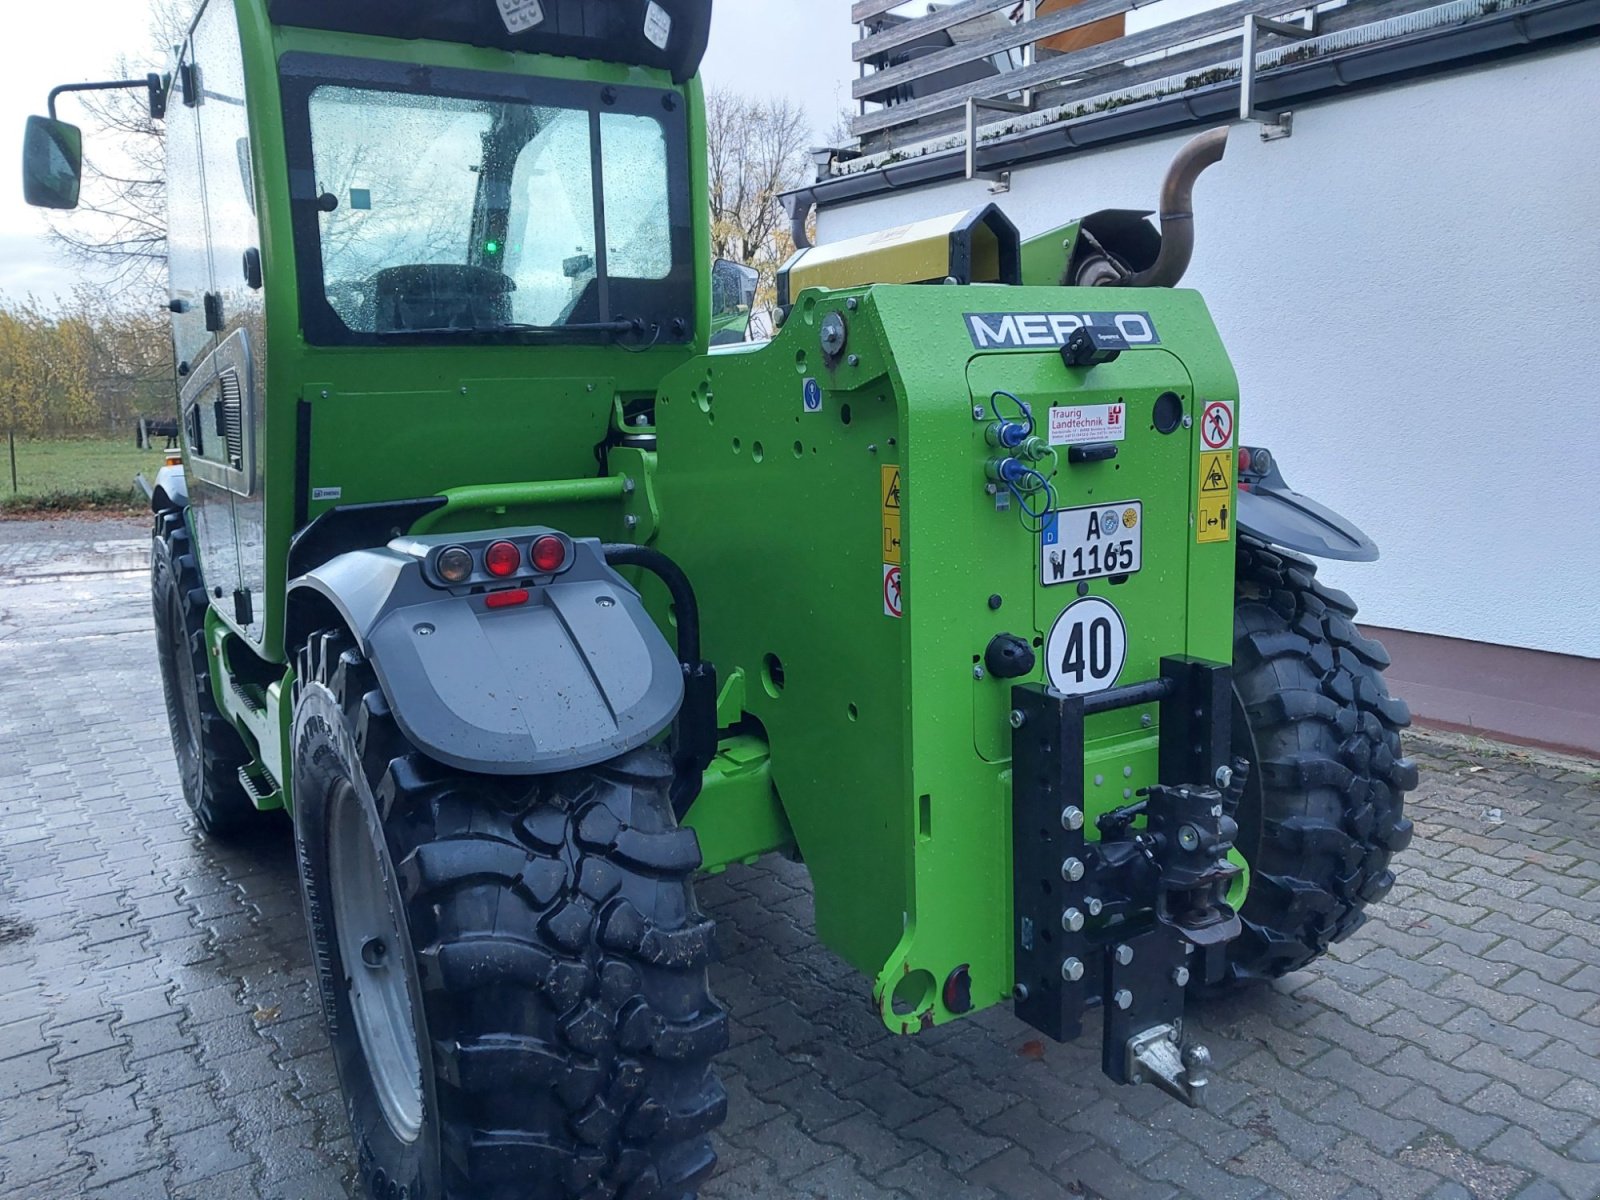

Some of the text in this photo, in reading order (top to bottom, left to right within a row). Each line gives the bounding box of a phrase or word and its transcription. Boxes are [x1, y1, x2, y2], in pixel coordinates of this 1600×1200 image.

[1052, 408, 1082, 419] Traurig
[1052, 417, 1103, 429] Landtechnik
[1086, 511, 1101, 541] A
[1047, 532, 1054, 542] D
[1050, 540, 1133, 580] W 1165
[1062, 617, 1111, 683] 40
